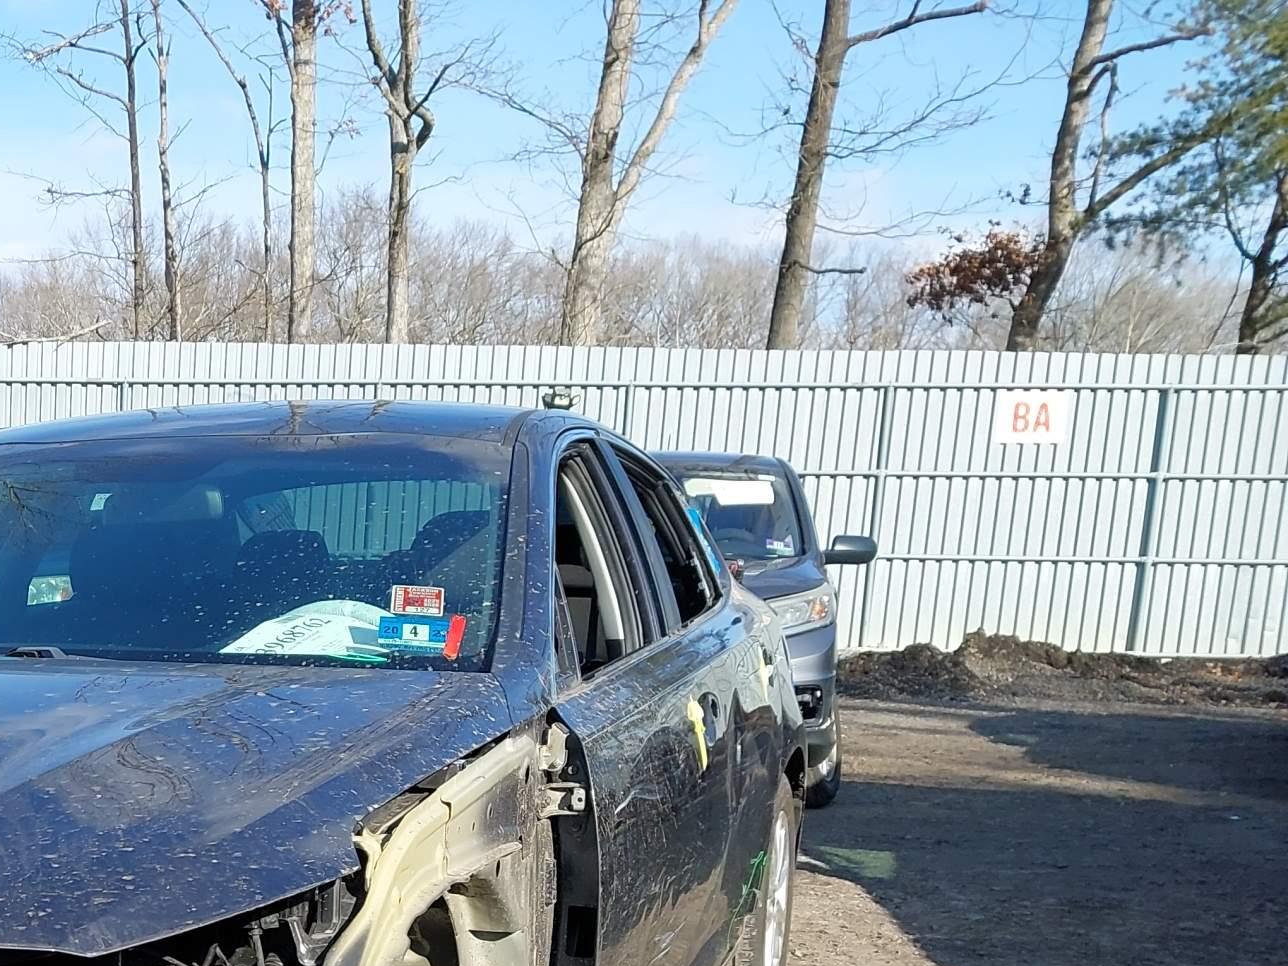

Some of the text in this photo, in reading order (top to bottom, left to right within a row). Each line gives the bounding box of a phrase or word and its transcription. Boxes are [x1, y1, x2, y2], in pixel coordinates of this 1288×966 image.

[1011, 401, 1050, 433] BA
[383, 625, 398, 634] 20
[409, 625, 418, 638] 4
